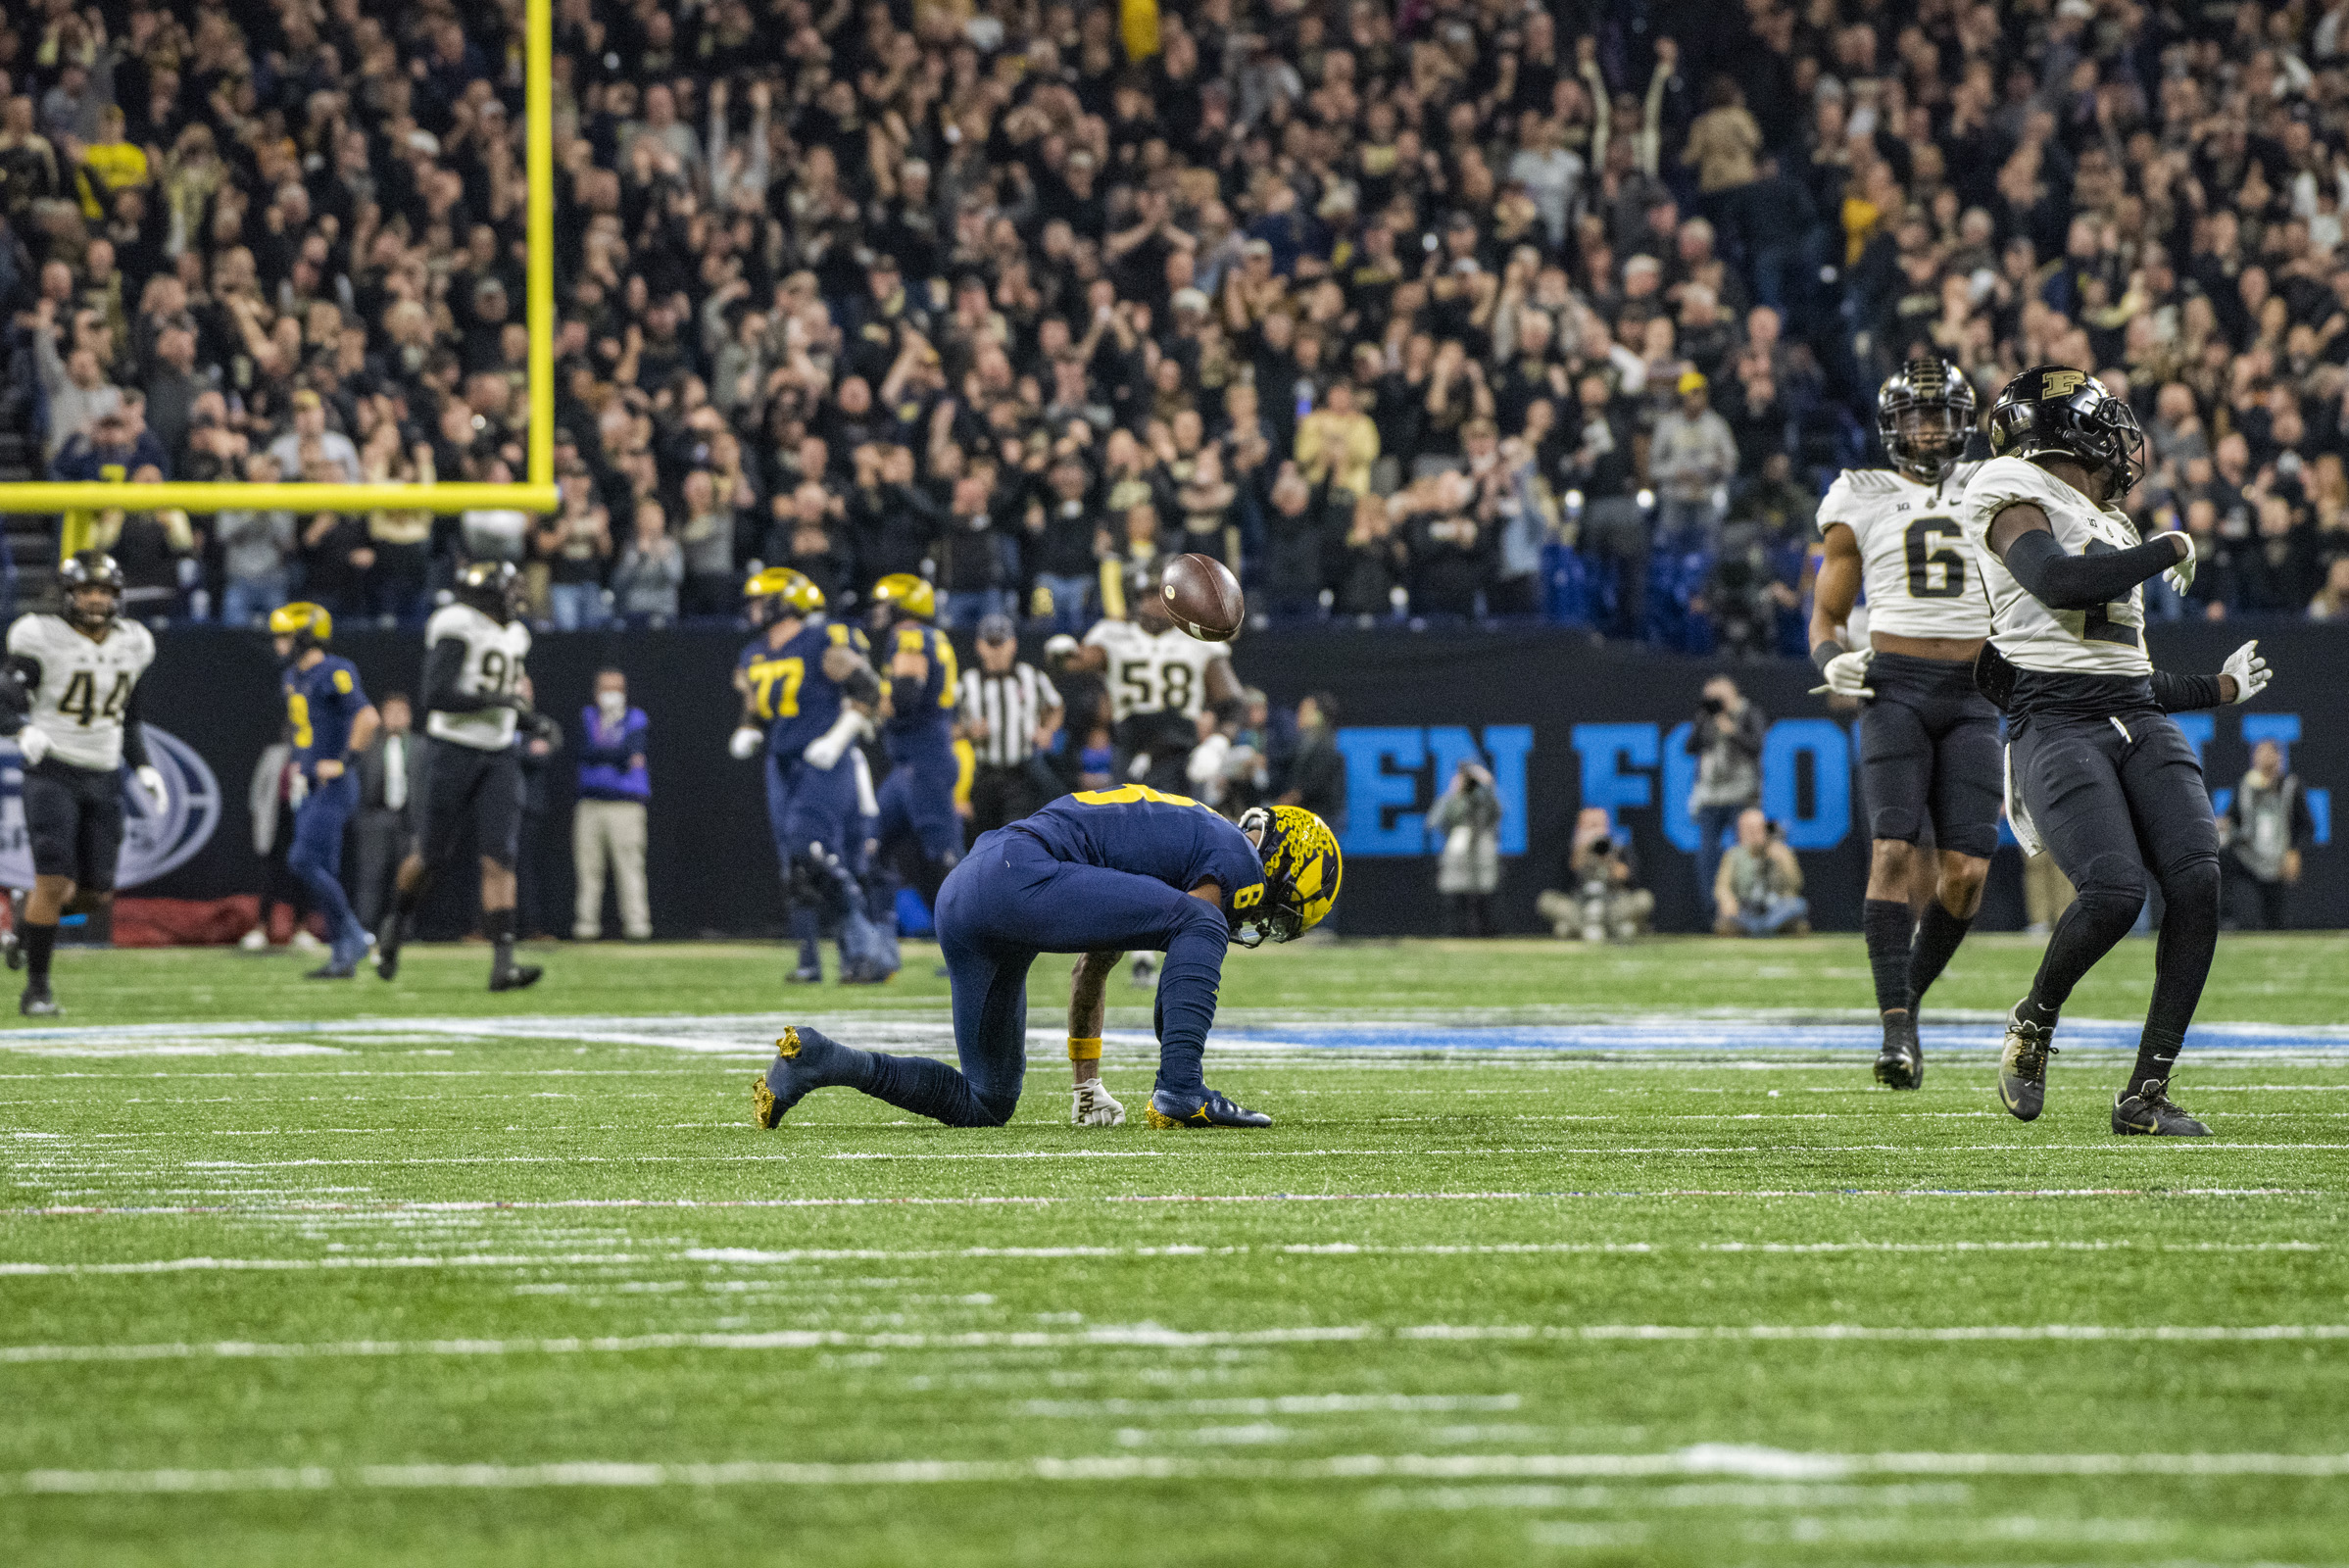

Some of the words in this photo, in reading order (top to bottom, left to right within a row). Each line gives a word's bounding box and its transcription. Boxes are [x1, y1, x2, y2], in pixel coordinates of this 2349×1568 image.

[1904, 516, 1966, 598] 6
[59, 670, 129, 727] 44
[749, 657, 805, 719] 77
[1121, 660, 1192, 710] 58
